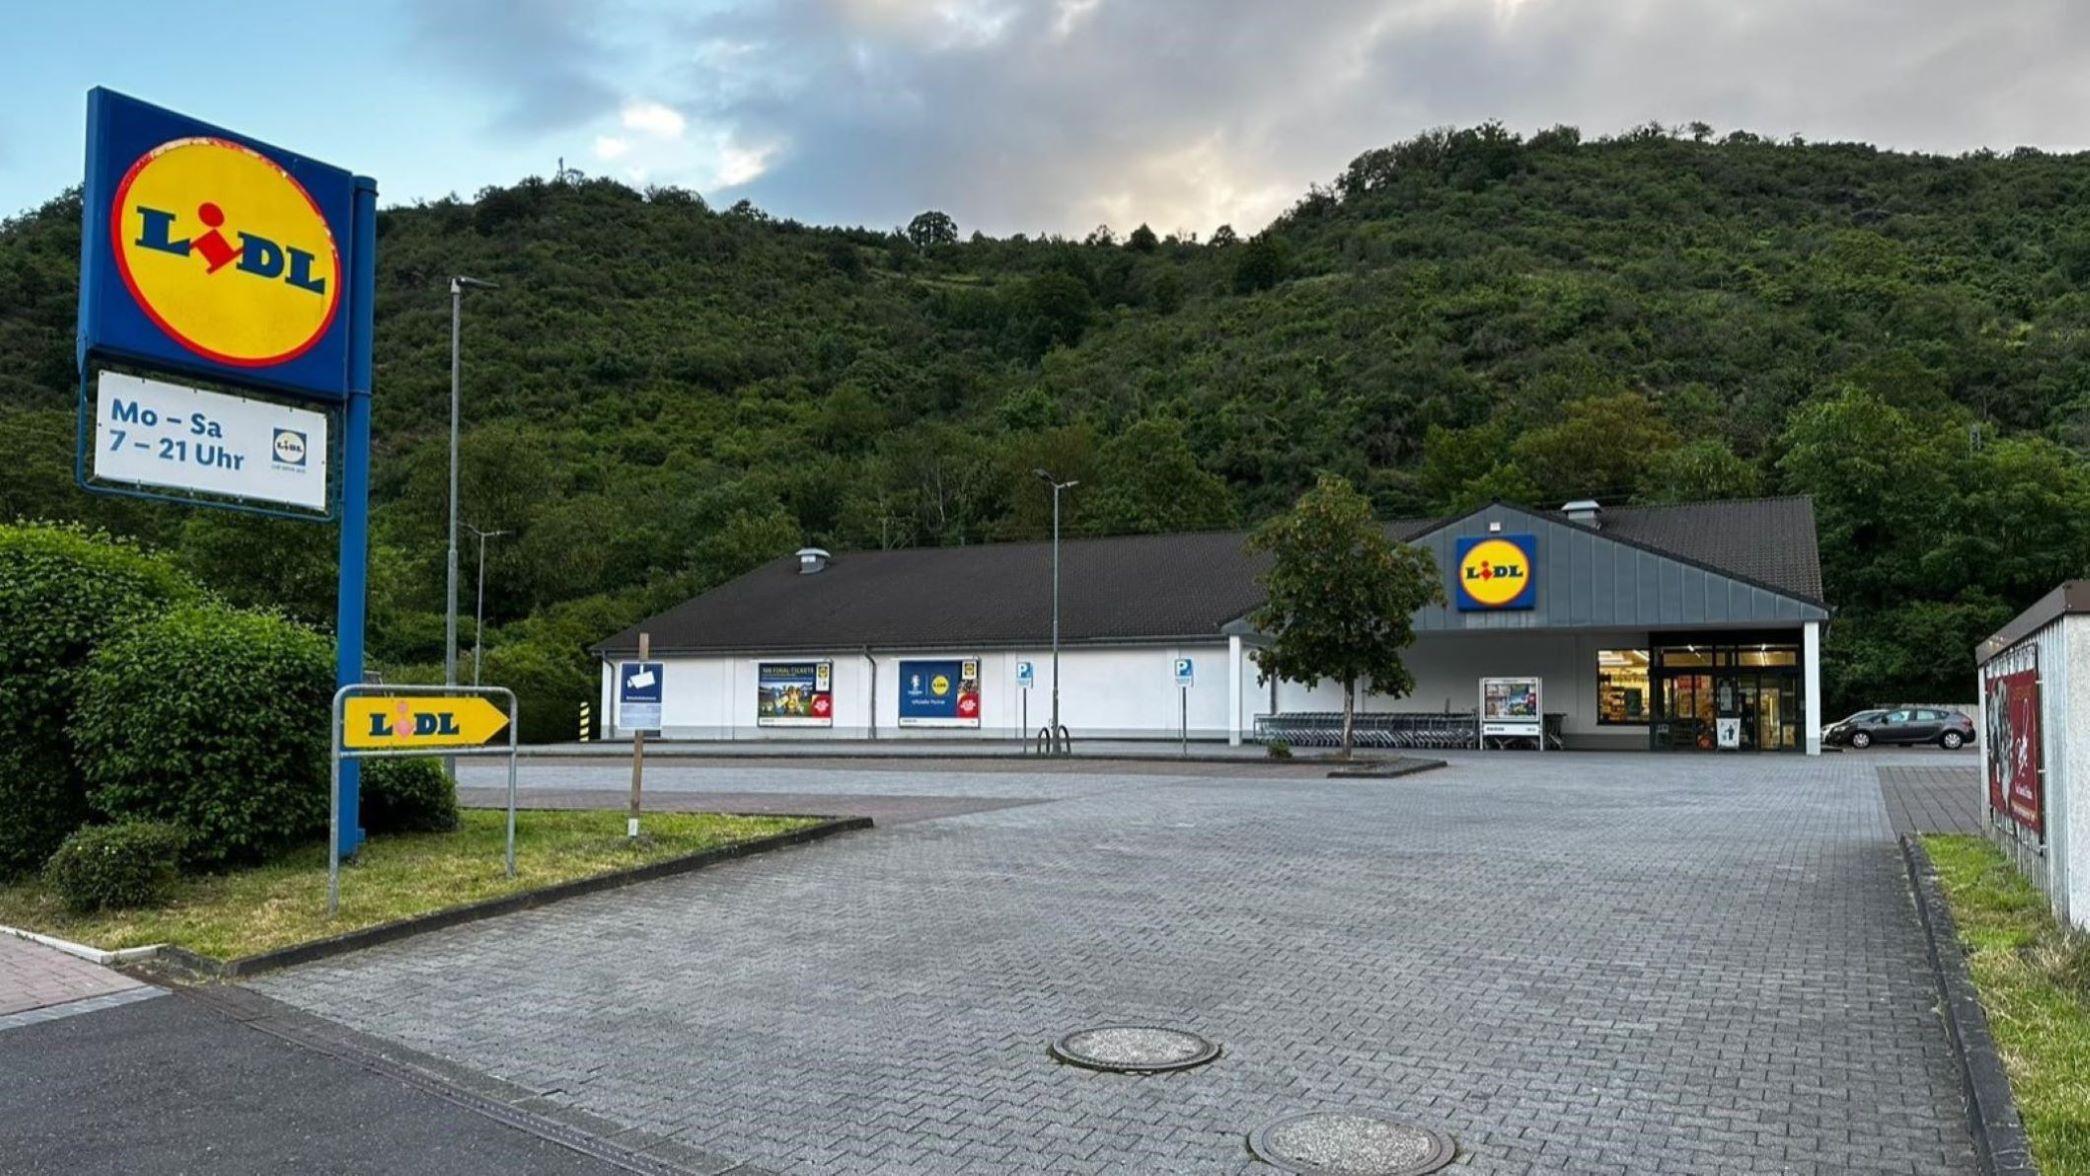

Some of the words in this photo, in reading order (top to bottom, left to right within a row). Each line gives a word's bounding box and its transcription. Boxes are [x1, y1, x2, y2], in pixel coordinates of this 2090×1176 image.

[111, 398, 158, 427] Mo
[190, 413, 223, 439] Sa
[109, 429, 126, 452] 7
[159, 437, 186, 462] 21
[196, 443, 245, 471] Uhr
